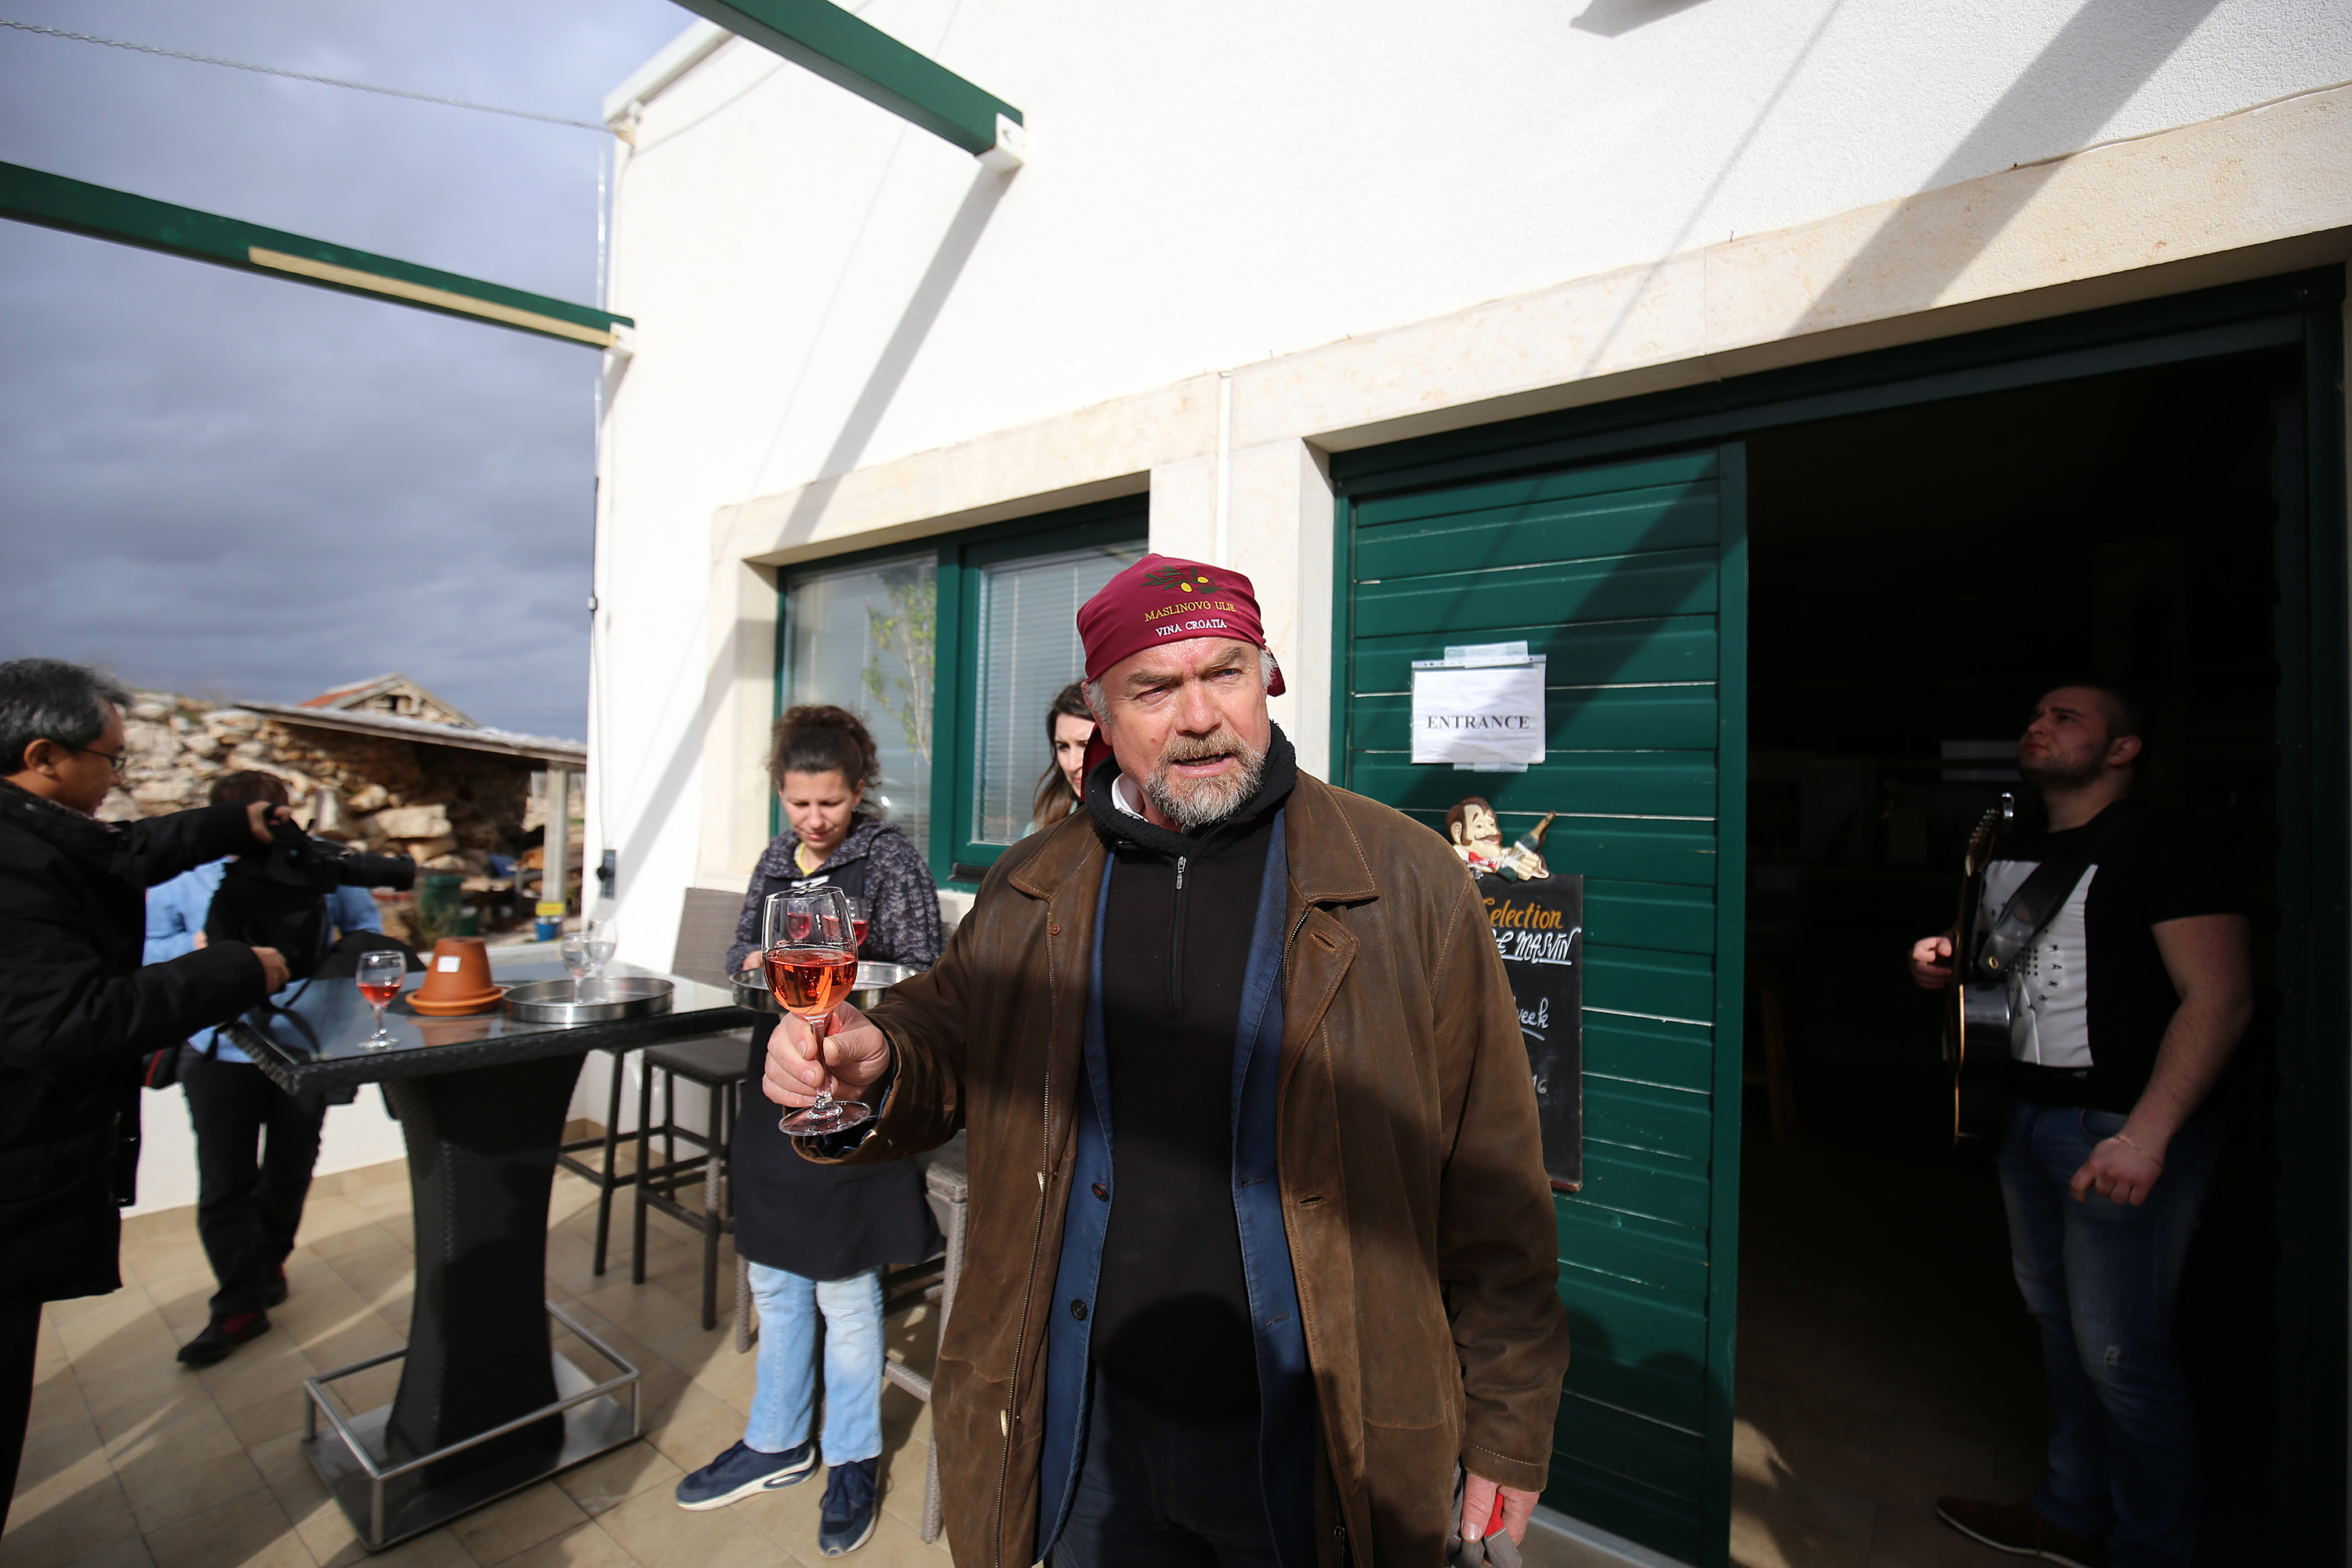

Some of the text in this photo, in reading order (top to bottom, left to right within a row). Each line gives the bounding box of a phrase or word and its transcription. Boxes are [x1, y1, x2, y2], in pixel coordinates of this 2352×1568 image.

[1145, 601, 1211, 622] MASLINOVO
[1156, 619, 1227, 637] VINA CROATIA
[1428, 716, 1530, 729] ENTRANCE
